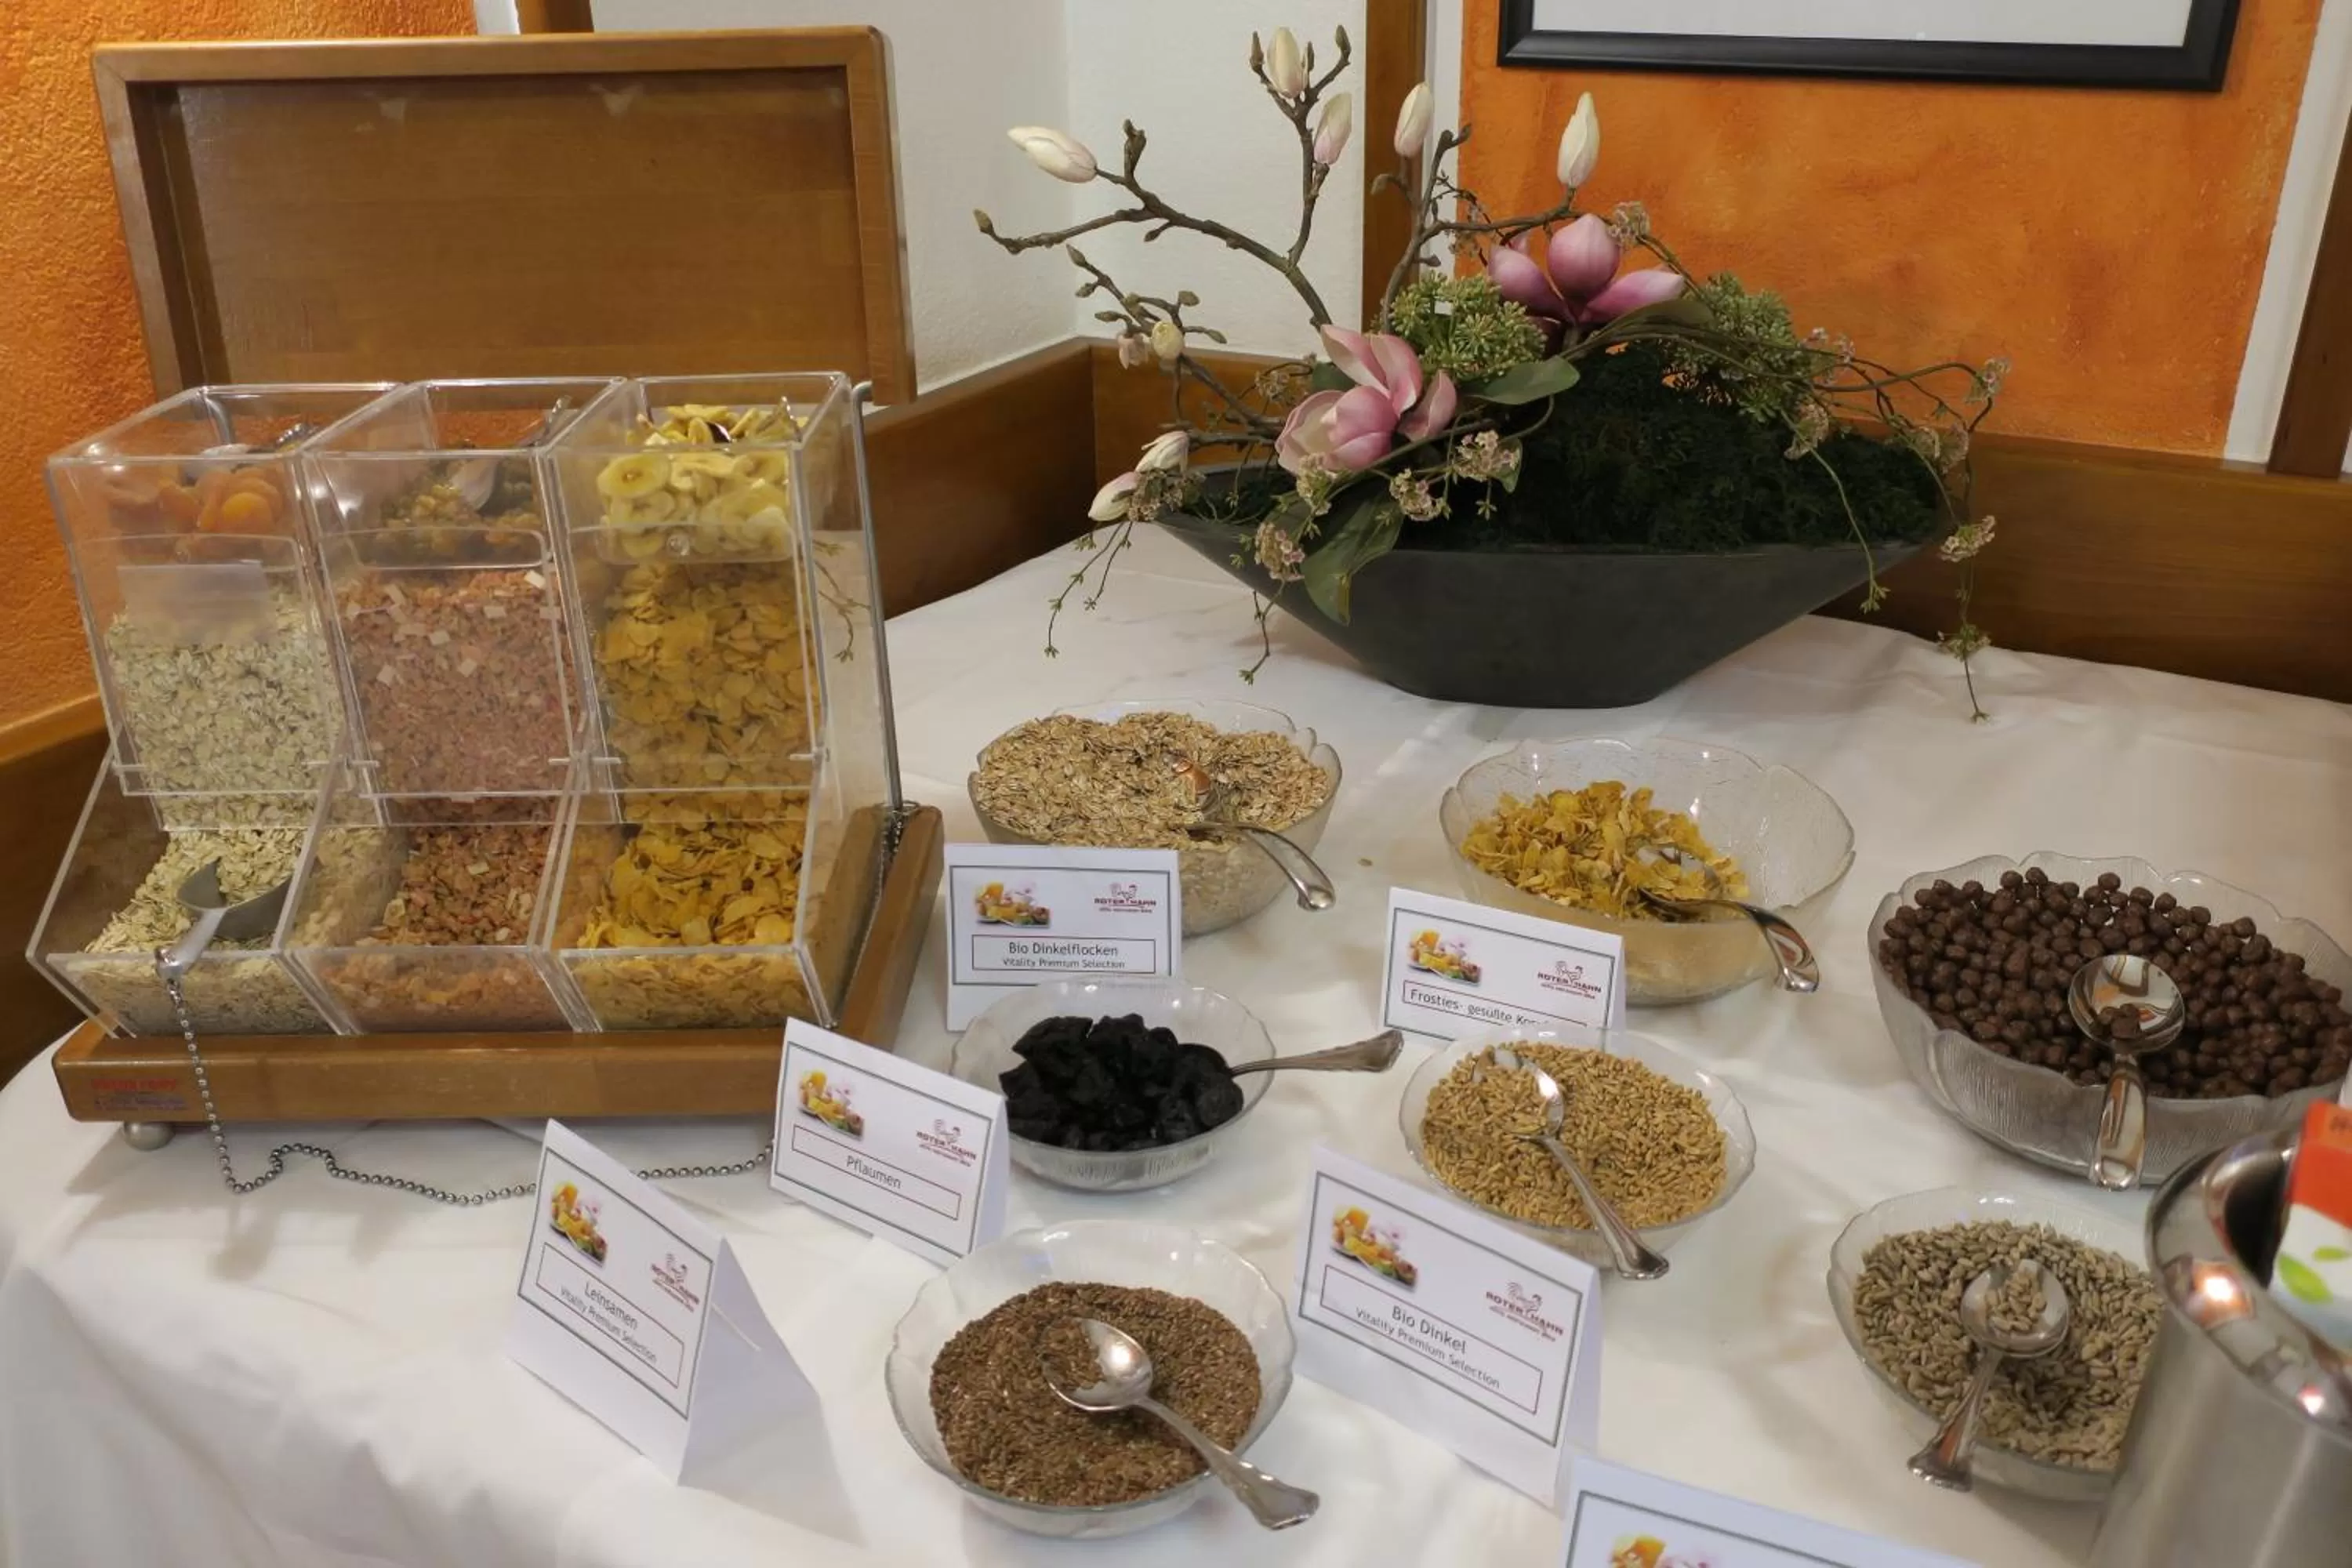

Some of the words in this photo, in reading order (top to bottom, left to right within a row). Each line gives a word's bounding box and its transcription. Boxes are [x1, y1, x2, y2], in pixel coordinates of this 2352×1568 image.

[1003, 957, 1036, 969] Vitality
[1039, 957, 1080, 968] Premium
[1082, 959, 1125, 970] Selection
[1009, 942, 1029, 955] Bio
[1033, 942, 1119, 956] Dinkelflocken
[846, 1155, 901, 1189] Pflaumen
[584, 1282, 638, 1330] Leinsamen
[1486, 1291, 1524, 1316] ROTER
[1392, 1305, 1415, 1329] Bio
[1420, 1319, 1466, 1355] Dinkel
[1356, 1307, 1395, 1335] Vitality
[1398, 1328, 1445, 1360] Premium
[1449, 1353, 1501, 1389] Selection
